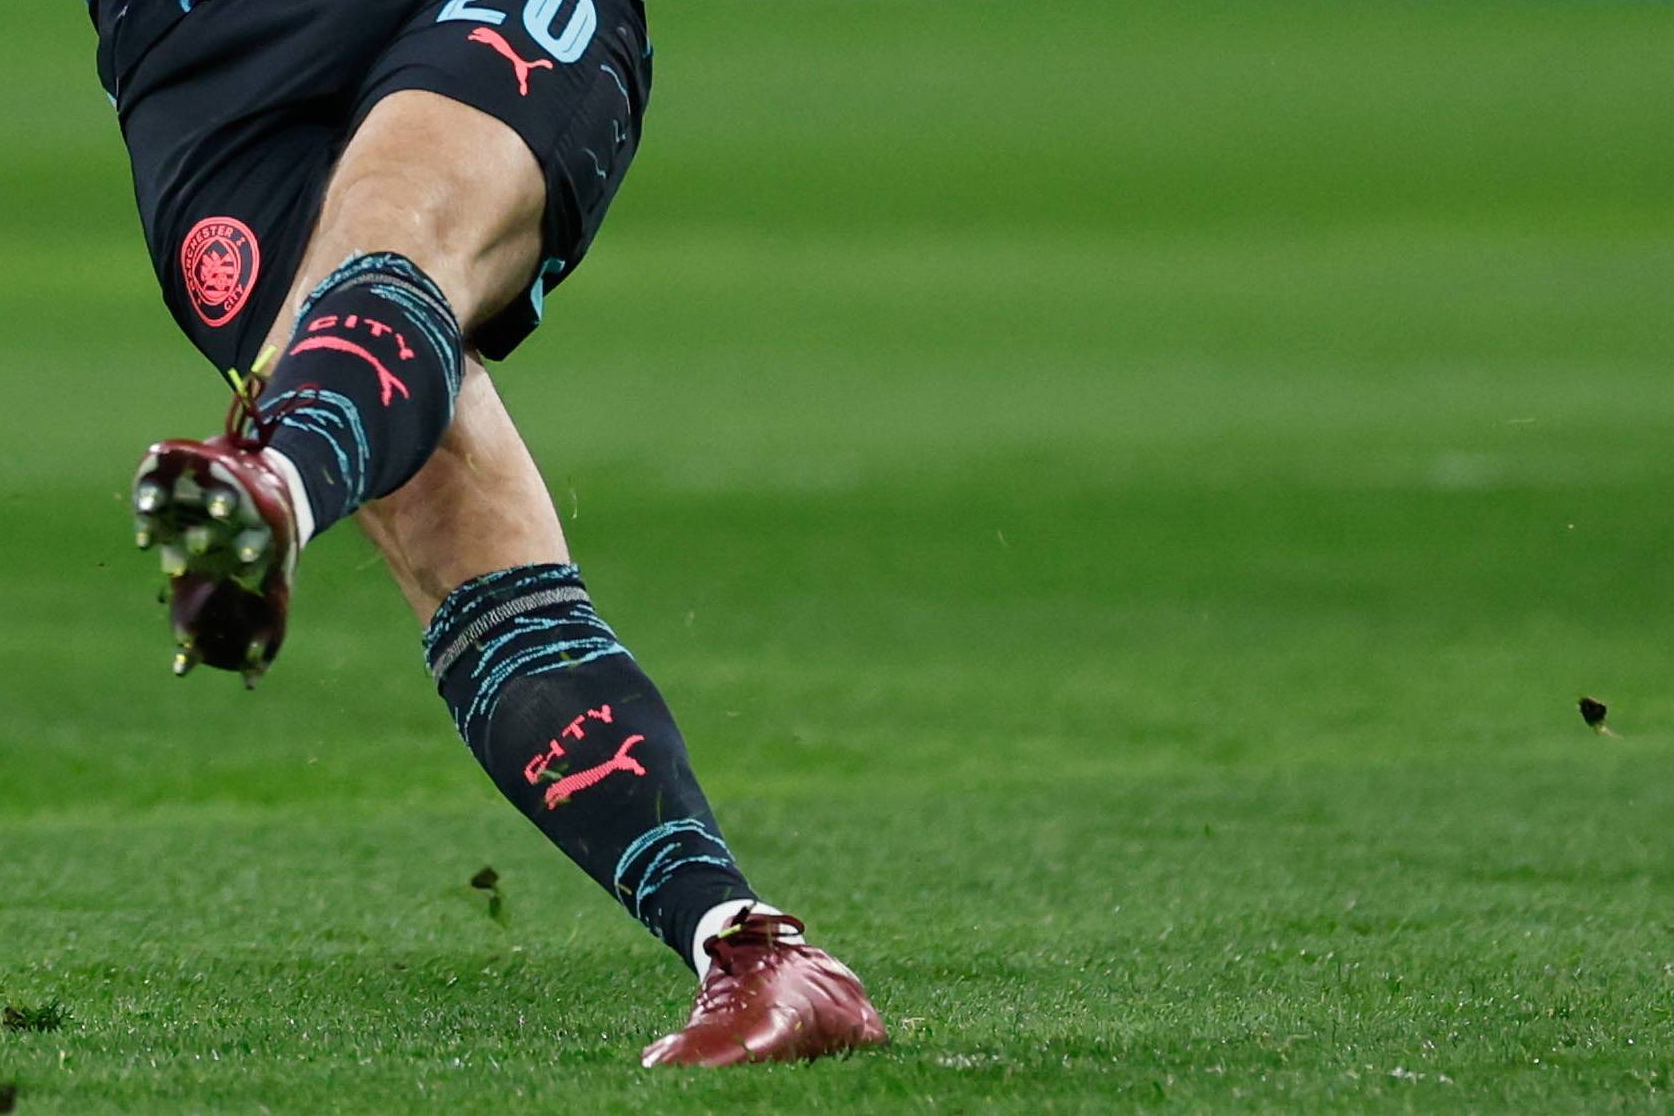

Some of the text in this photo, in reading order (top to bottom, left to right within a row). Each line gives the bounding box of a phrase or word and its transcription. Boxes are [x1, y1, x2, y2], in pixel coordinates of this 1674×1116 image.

[223, 284, 245, 312] CITY
[308, 314, 416, 361] CITY
[524, 704, 614, 785] CITY
